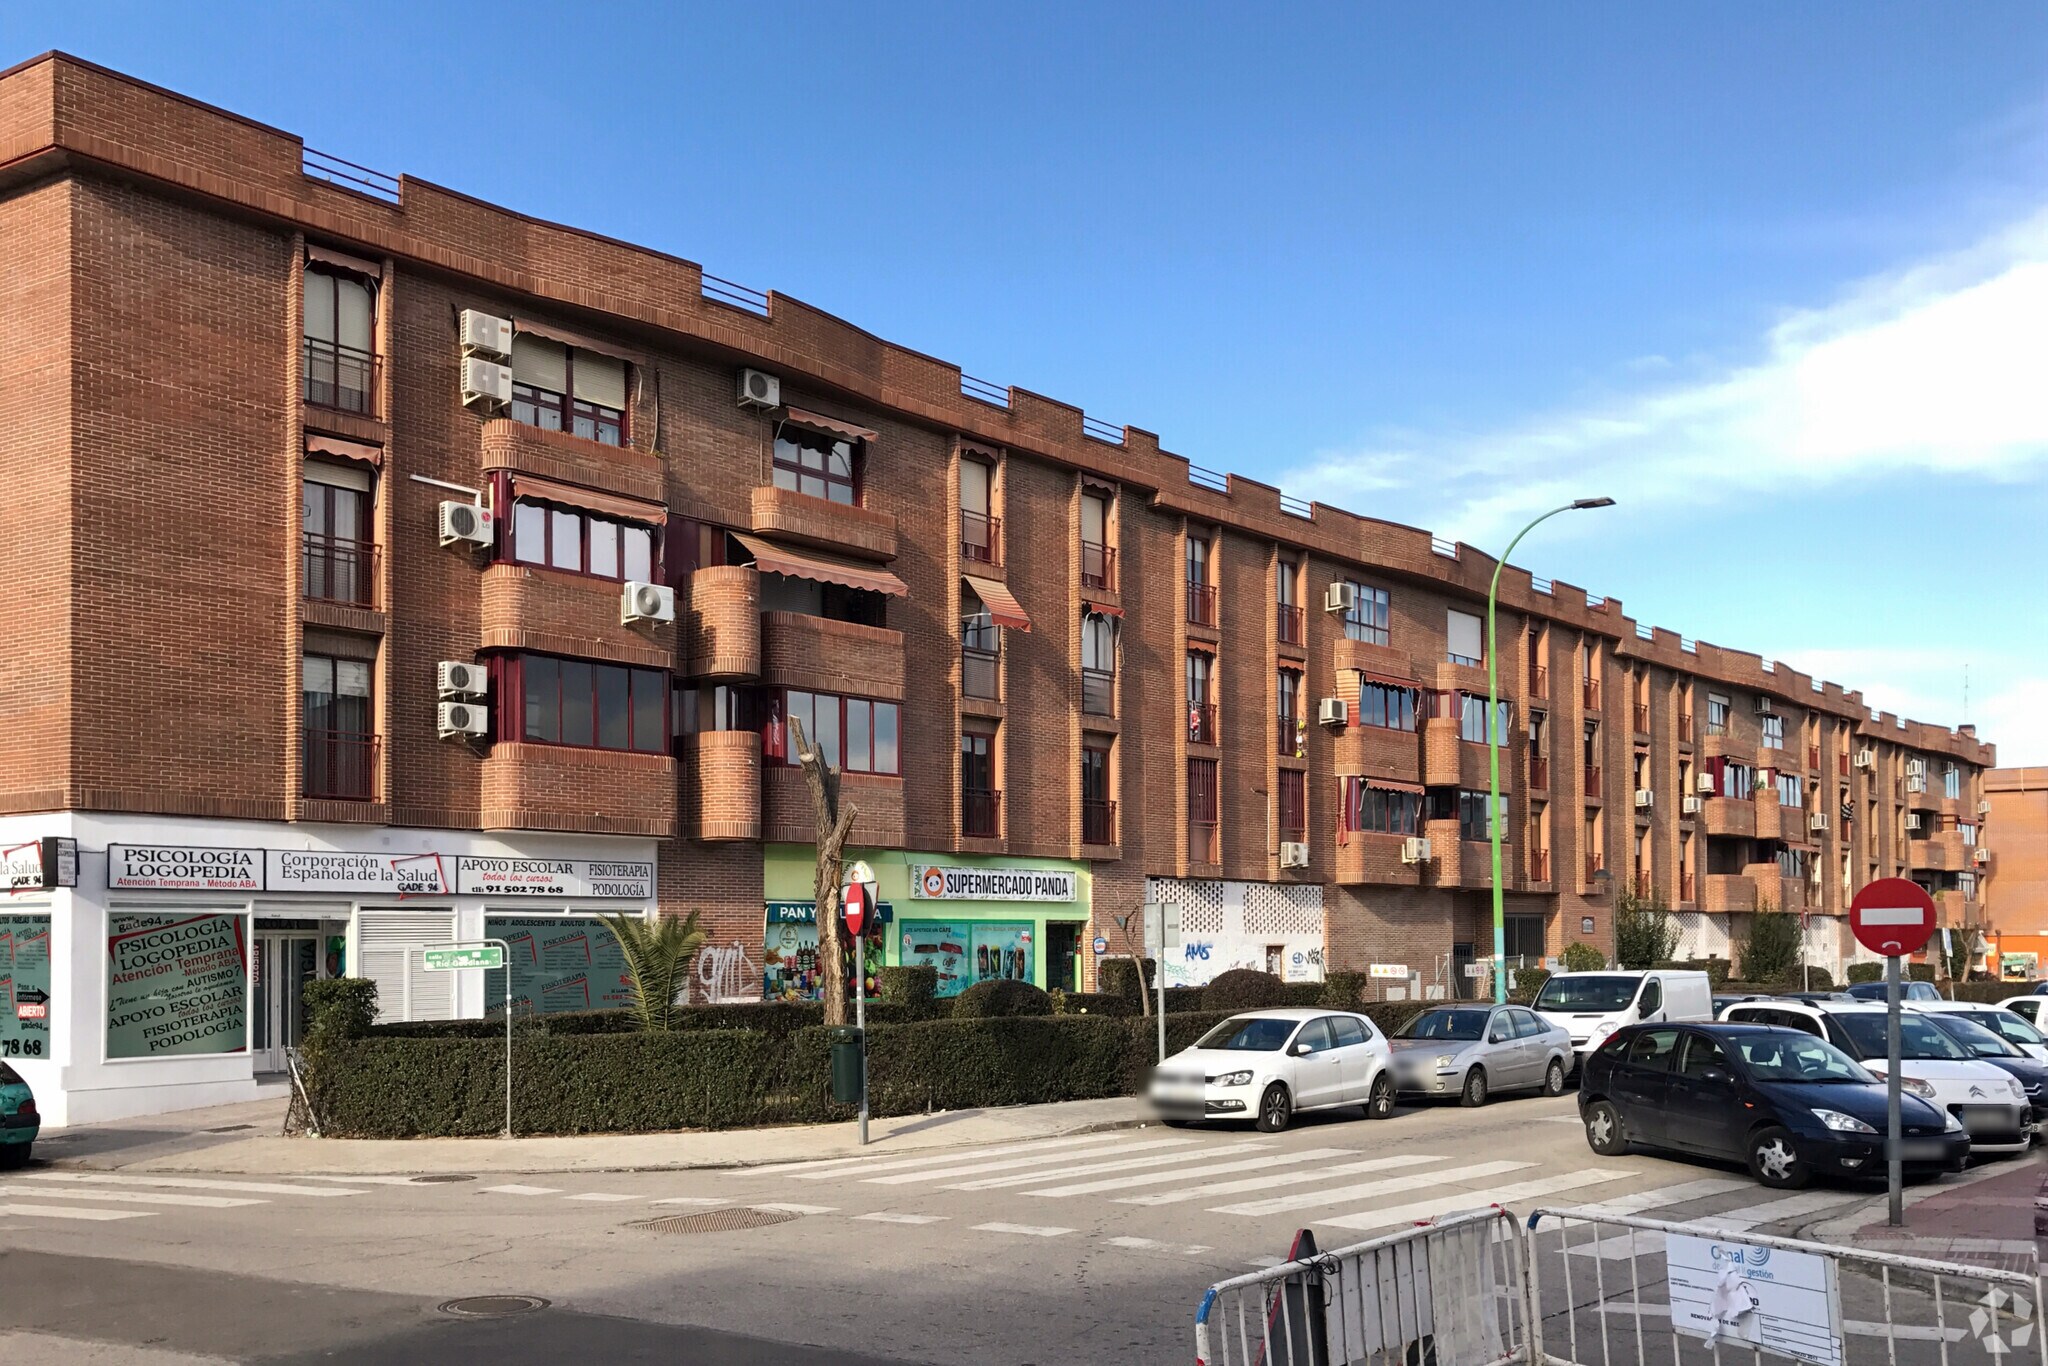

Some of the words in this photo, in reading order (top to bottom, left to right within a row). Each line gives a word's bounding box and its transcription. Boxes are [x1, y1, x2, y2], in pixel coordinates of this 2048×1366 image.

[123, 849, 253, 865] PSICOLOGÍA
[281, 852, 379, 868] Corporación
[126, 864, 251, 879] LOGOPEDIA
[281, 866, 355, 883] Española
[357, 868, 377, 881] de
[381, 867, 394, 881] la
[398, 868, 438, 882] Salud
[461, 859, 509, 872] APOYO
[513, 861, 574, 875] ESCOLAR
[589, 863, 649, 878] FISIOTERAPIA
[11, 876, 31, 886] GADE
[117, 877, 156, 887] Atención
[158, 878, 200, 889] Temprana
[207, 879, 238, 888] Método
[239, 879, 257, 888] ABA
[482, 872, 507, 882] todos
[510, 872, 523, 882] los
[526, 874, 554, 883] cursos
[946, 873, 1033, 895] SUPERMERCADO
[1035, 876, 1069, 896] PANDA
[398, 882, 424, 892] GADE
[427, 882, 438, 892] 94
[486, 884, 501, 893] 91
[504, 885, 528, 893] 502
[529, 885, 545, 893] 78
[547, 885, 564, 894] 68
[592, 881, 646, 897] PODOLOGÍA
[780, 906, 806, 919] PAN
[809, 906, 817, 919] Y
[487, 918, 507, 927] NIÑOS
[510, 919, 556, 927] ADOLESCENTES
[560, 919, 586, 927] ADULTOS
[118, 919, 232, 955] PSICOLOGÍA
[120, 936, 230, 971] LOGOPEDIA
[112, 963, 173, 985] Atención
[175, 947, 239, 969] Temprana
[541, 972, 587, 991] FISIOTERAPIA
[18, 1005, 45, 1017] ABIERTO
[109, 1006, 166, 1030] APOYO
[169, 986, 244, 1013] ESCOLAR
[486, 994, 529, 1012] PODOOGÍA
[143, 1005, 243, 1038] FISIOTERAPIA
[149, 1017, 244, 1051] PODOLOGÍA
[2, 1039, 20, 1057] 78
[23, 1039, 42, 1056] 68
[1711, 1245, 1745, 1264] Cnal
[1746, 1268, 1774, 1279] gestión
